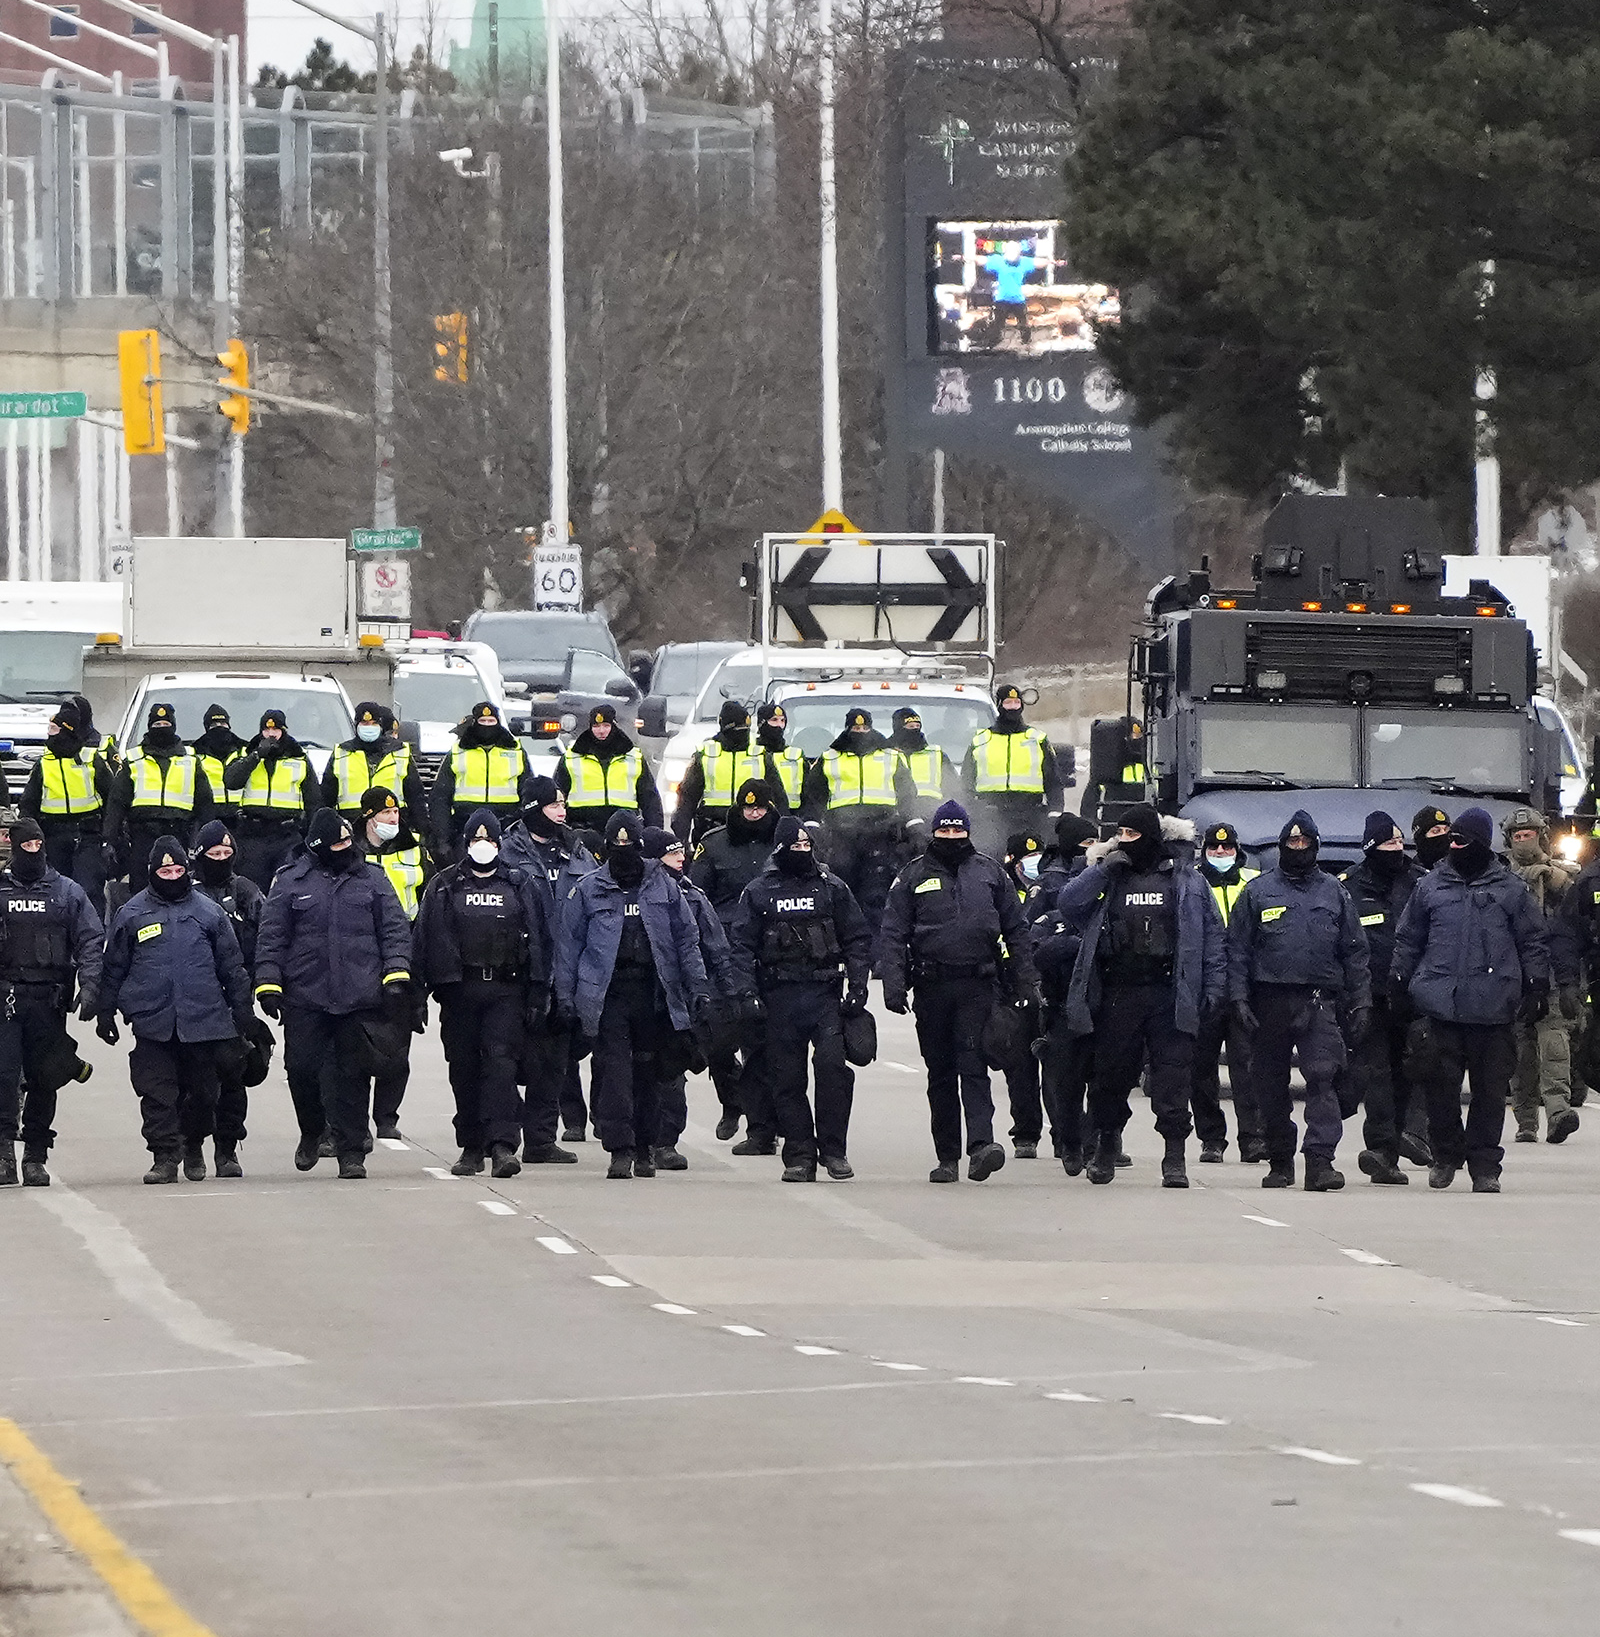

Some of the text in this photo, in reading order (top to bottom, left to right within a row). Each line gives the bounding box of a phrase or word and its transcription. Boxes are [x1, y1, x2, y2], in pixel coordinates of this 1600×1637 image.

[541, 568, 577, 594] 60
[940, 818, 964, 826] POLICE
[465, 893, 504, 907] POLICE
[776, 897, 815, 912] POLICE
[1125, 893, 1164, 906] POLICE
[8, 900, 46, 913] POLICE
